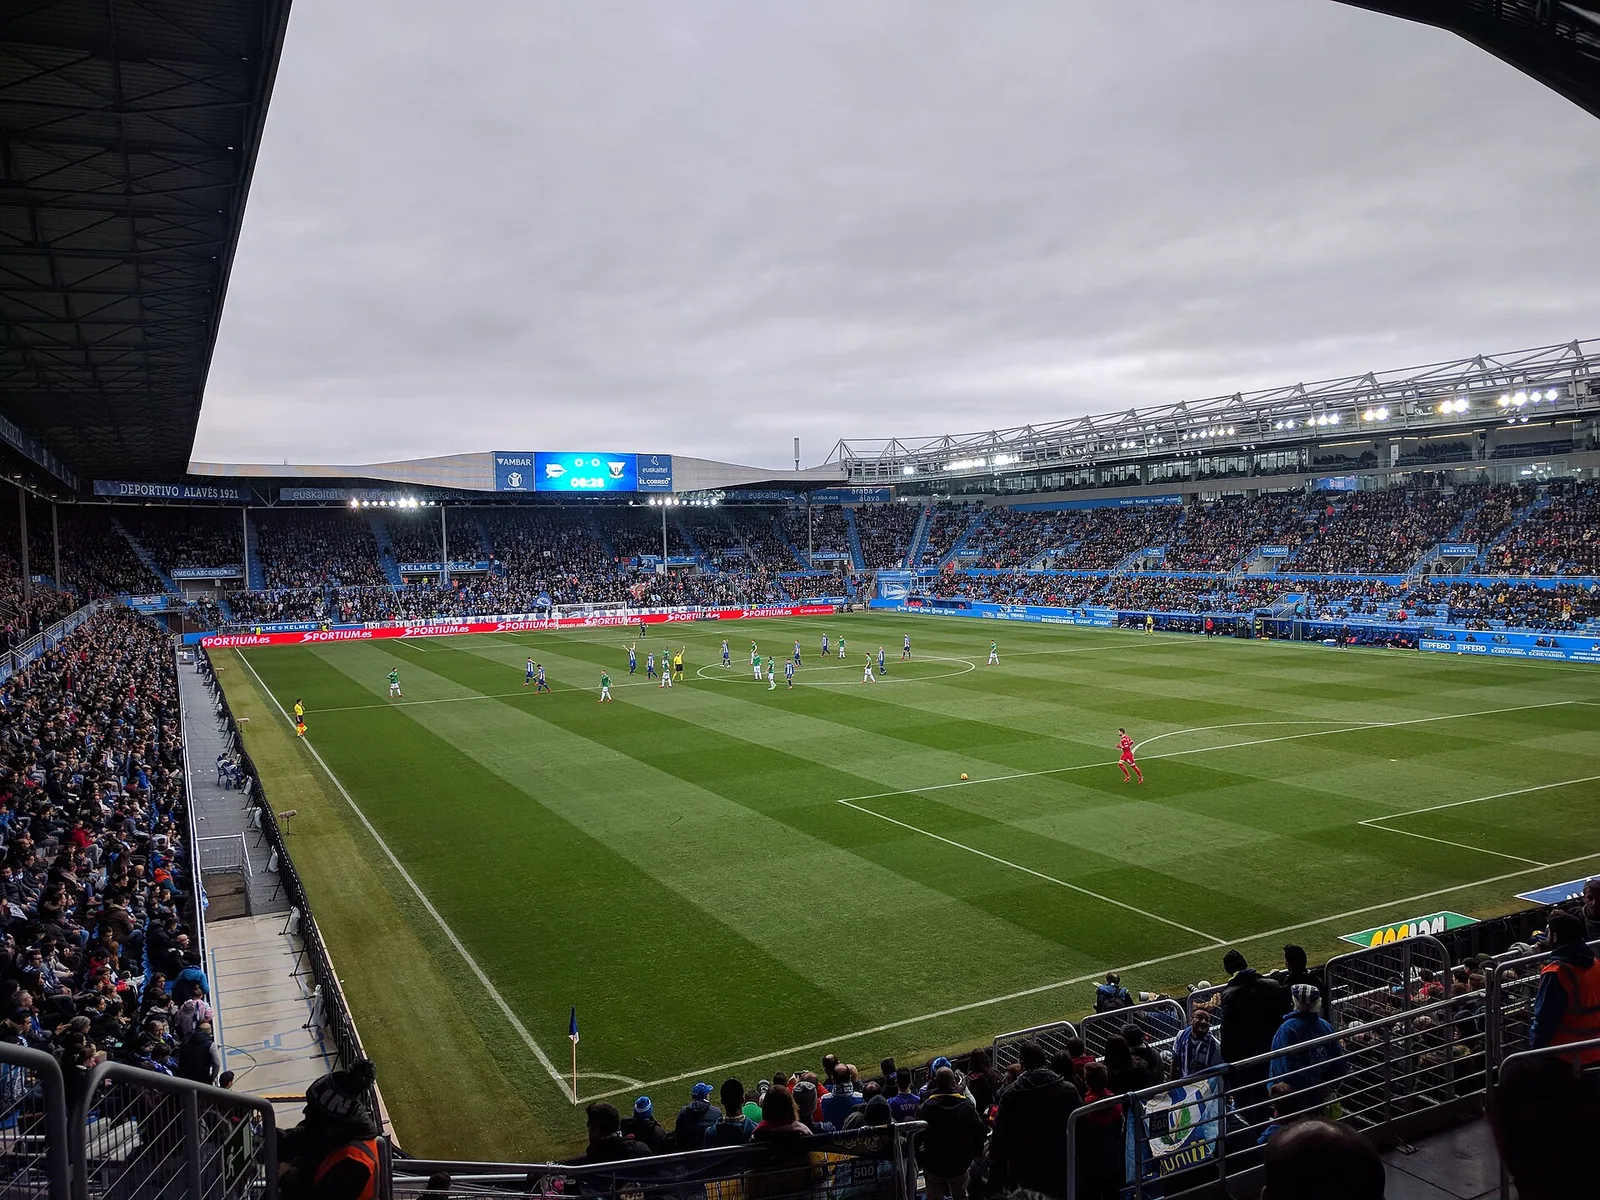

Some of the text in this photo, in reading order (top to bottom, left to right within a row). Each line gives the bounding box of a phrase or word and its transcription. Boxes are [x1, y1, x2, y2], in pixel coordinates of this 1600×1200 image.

[503, 458, 532, 466] AMBAR
[575, 458, 584, 467] 0
[591, 458, 600, 467] 0
[120, 483, 239, 499] DEPORTIVO ALAVÉS 1921
[293, 489, 338, 499] euskaltel
[401, 563, 434, 571] KELME
[741, 608, 793, 619] SPORTIUM.es
[300, 629, 373, 643] SPORTIUM.es
[400, 625, 470, 638] SPORTIUM.es
[202, 634, 270, 648] SPORTIUM.es
[1428, 641, 1451, 650] PFERD
[1463, 644, 1487, 653] PFERD
[1152, 1119, 1168, 1131] 500
[853, 1165, 875, 1178] 500
